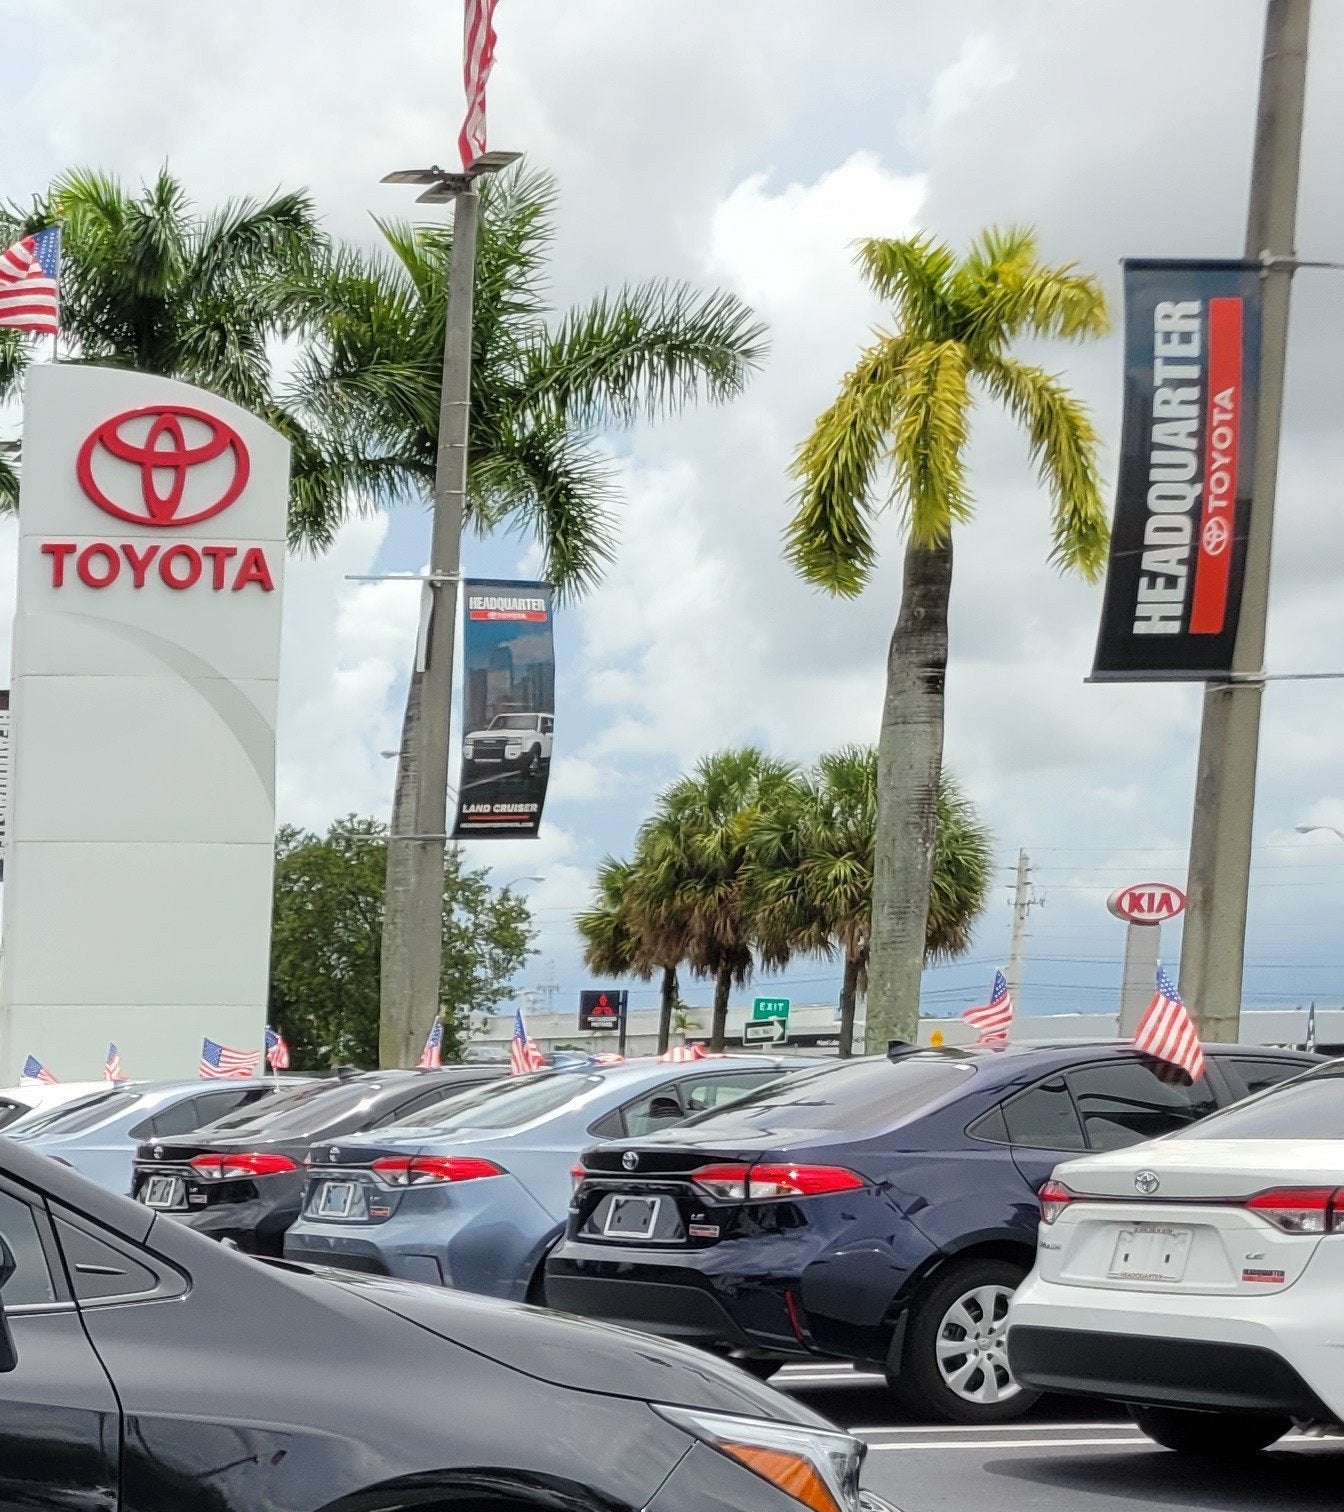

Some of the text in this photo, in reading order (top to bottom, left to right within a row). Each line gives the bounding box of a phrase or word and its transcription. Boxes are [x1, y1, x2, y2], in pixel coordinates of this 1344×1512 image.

[1207, 387, 1236, 513] TOYOTA
[1132, 299, 1204, 635] HEADQUARTER
[41, 542, 274, 592] TOYOTA
[468, 596, 546, 612] HEADQUARTER
[462, 802, 538, 813] LAND CRUISER
[1128, 892, 1174, 914] KIA
[759, 1002, 785, 1011] EXIT
